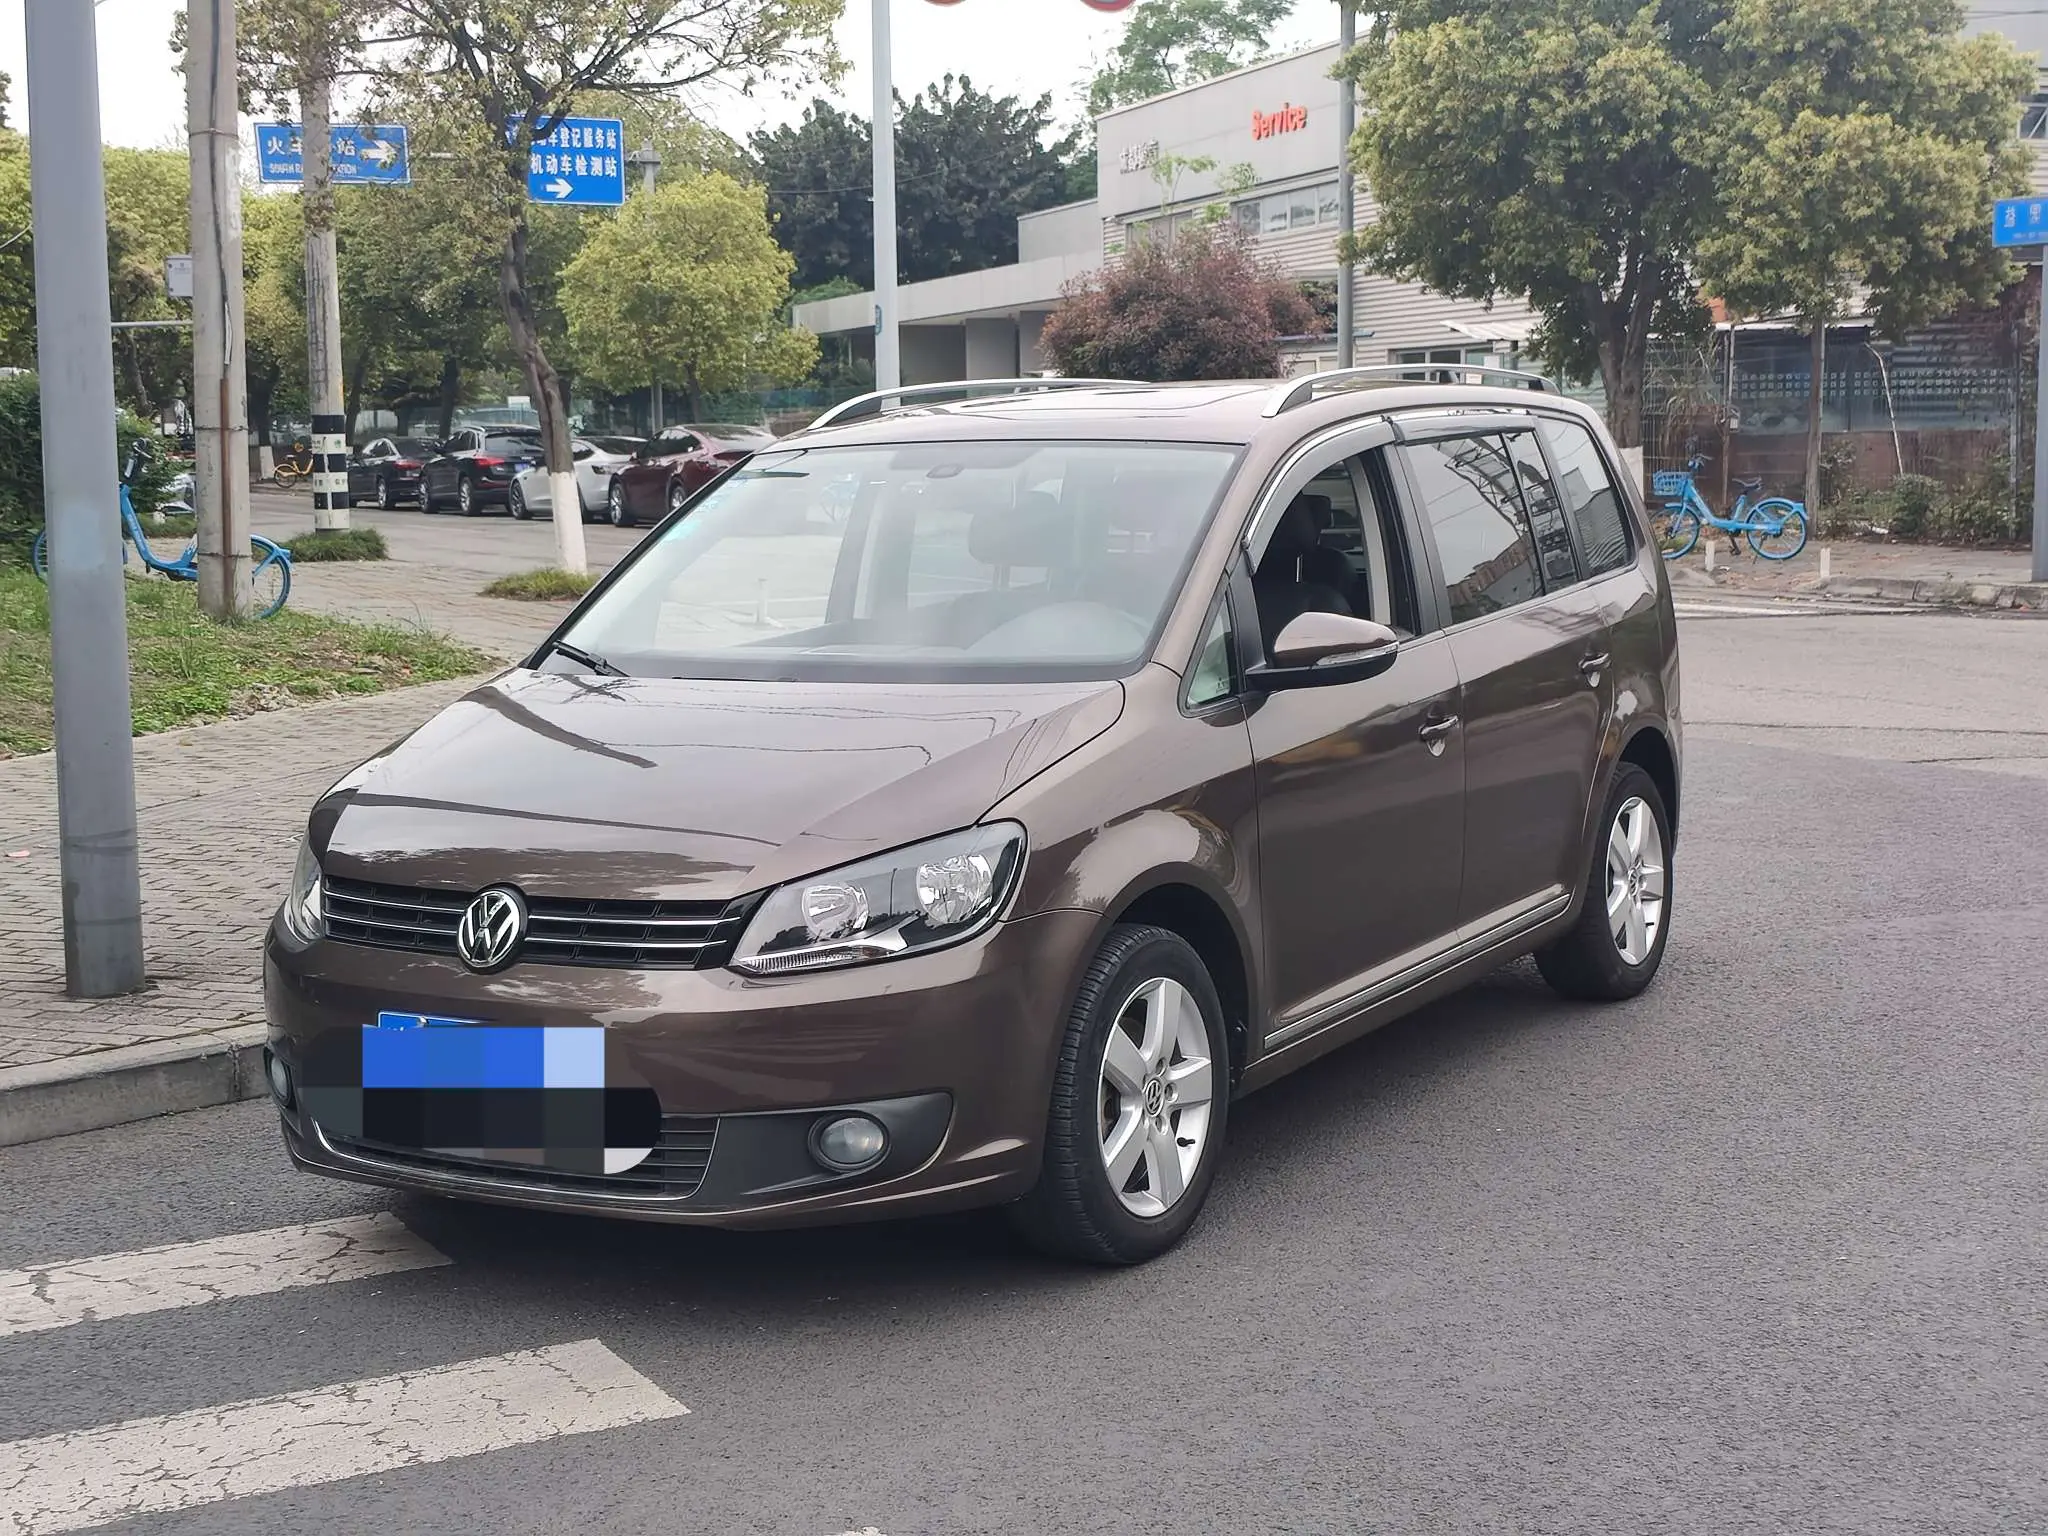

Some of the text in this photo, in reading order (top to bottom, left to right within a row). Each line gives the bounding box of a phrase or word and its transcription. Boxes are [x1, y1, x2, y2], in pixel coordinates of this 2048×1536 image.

[1252, 103, 1307, 140] Service
[530, 127, 617, 150] 车登记服务站
[530, 153, 617, 177] 机动车检测站
